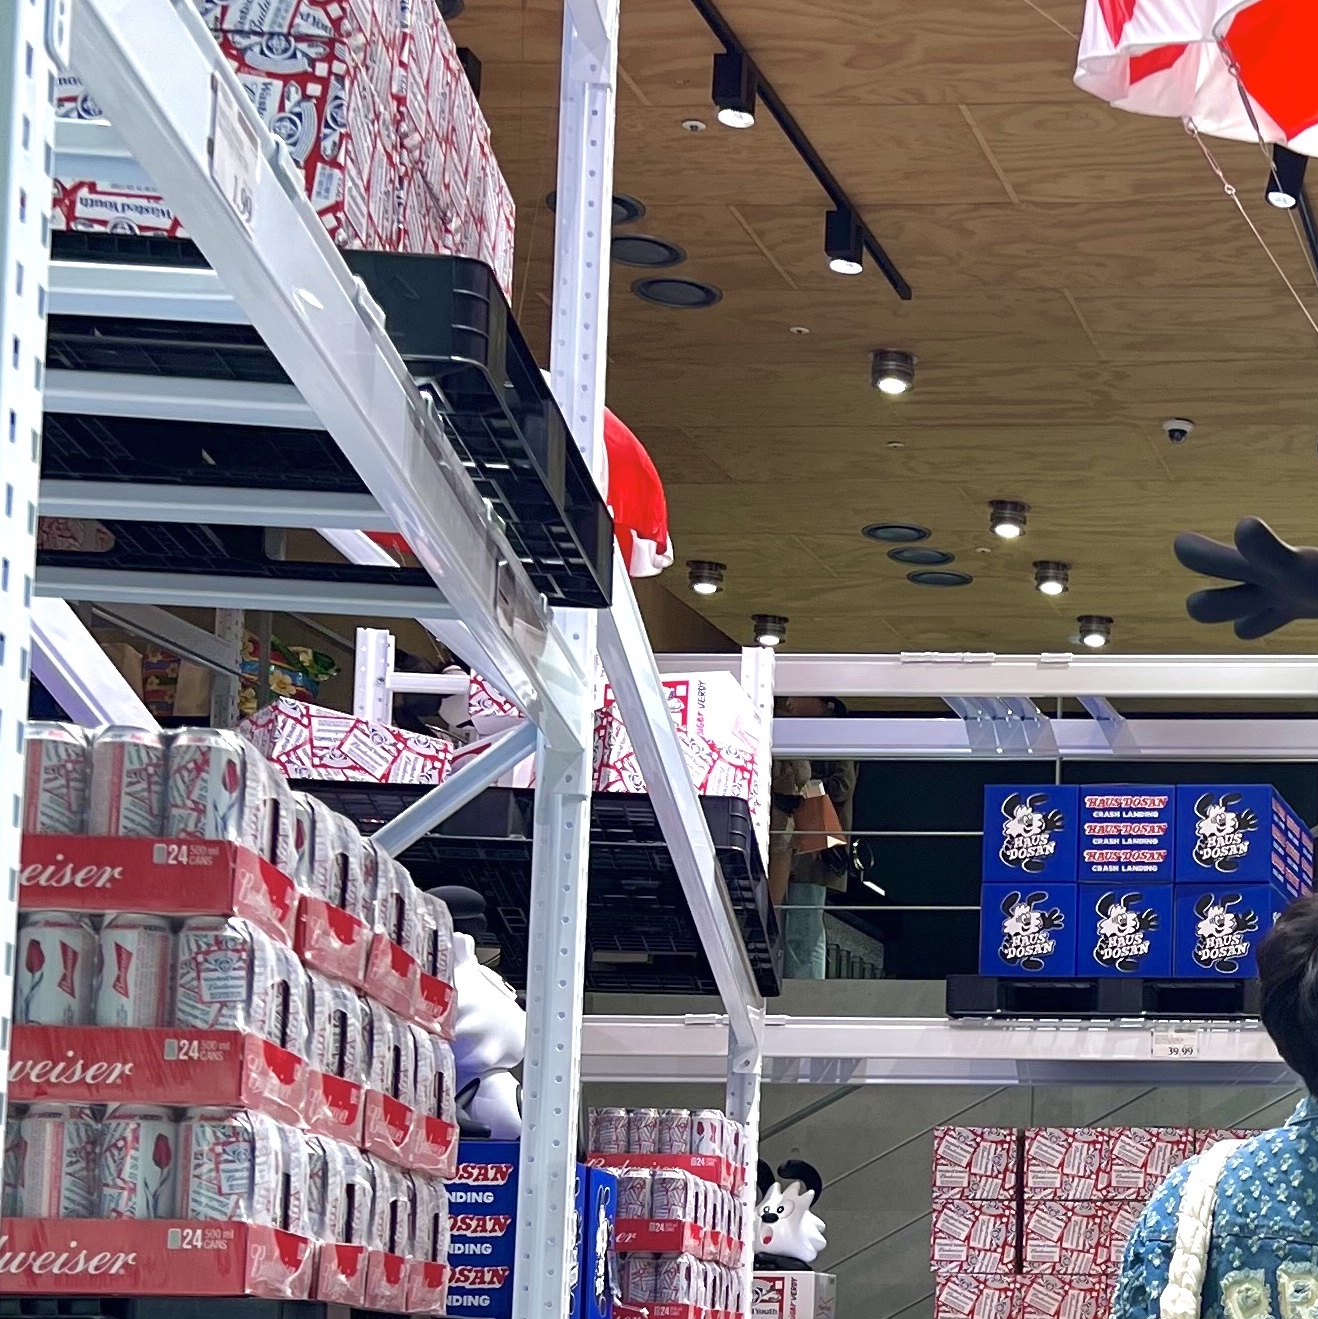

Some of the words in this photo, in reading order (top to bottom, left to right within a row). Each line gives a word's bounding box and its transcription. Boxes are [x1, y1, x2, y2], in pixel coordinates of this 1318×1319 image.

[1013, 834, 1050, 850] HAUS
[1206, 832, 1243, 848] HAUS
[168, 845, 188, 865] 24
[1006, 842, 1056, 861] DOSAN
[1200, 841, 1250, 860] DOSAN
[1011, 932, 1047, 948] HAUS
[1108, 932, 1144, 948] HAUS
[1205, 933, 1242, 948] HAUS
[1005, 940, 1055, 960] DOSAN
[1101, 940, 1151, 960] DOSAN
[1199, 942, 1249, 961] DOSAN
[178, 1040, 199, 1060] 24
[182, 1228, 203, 1249] 24
